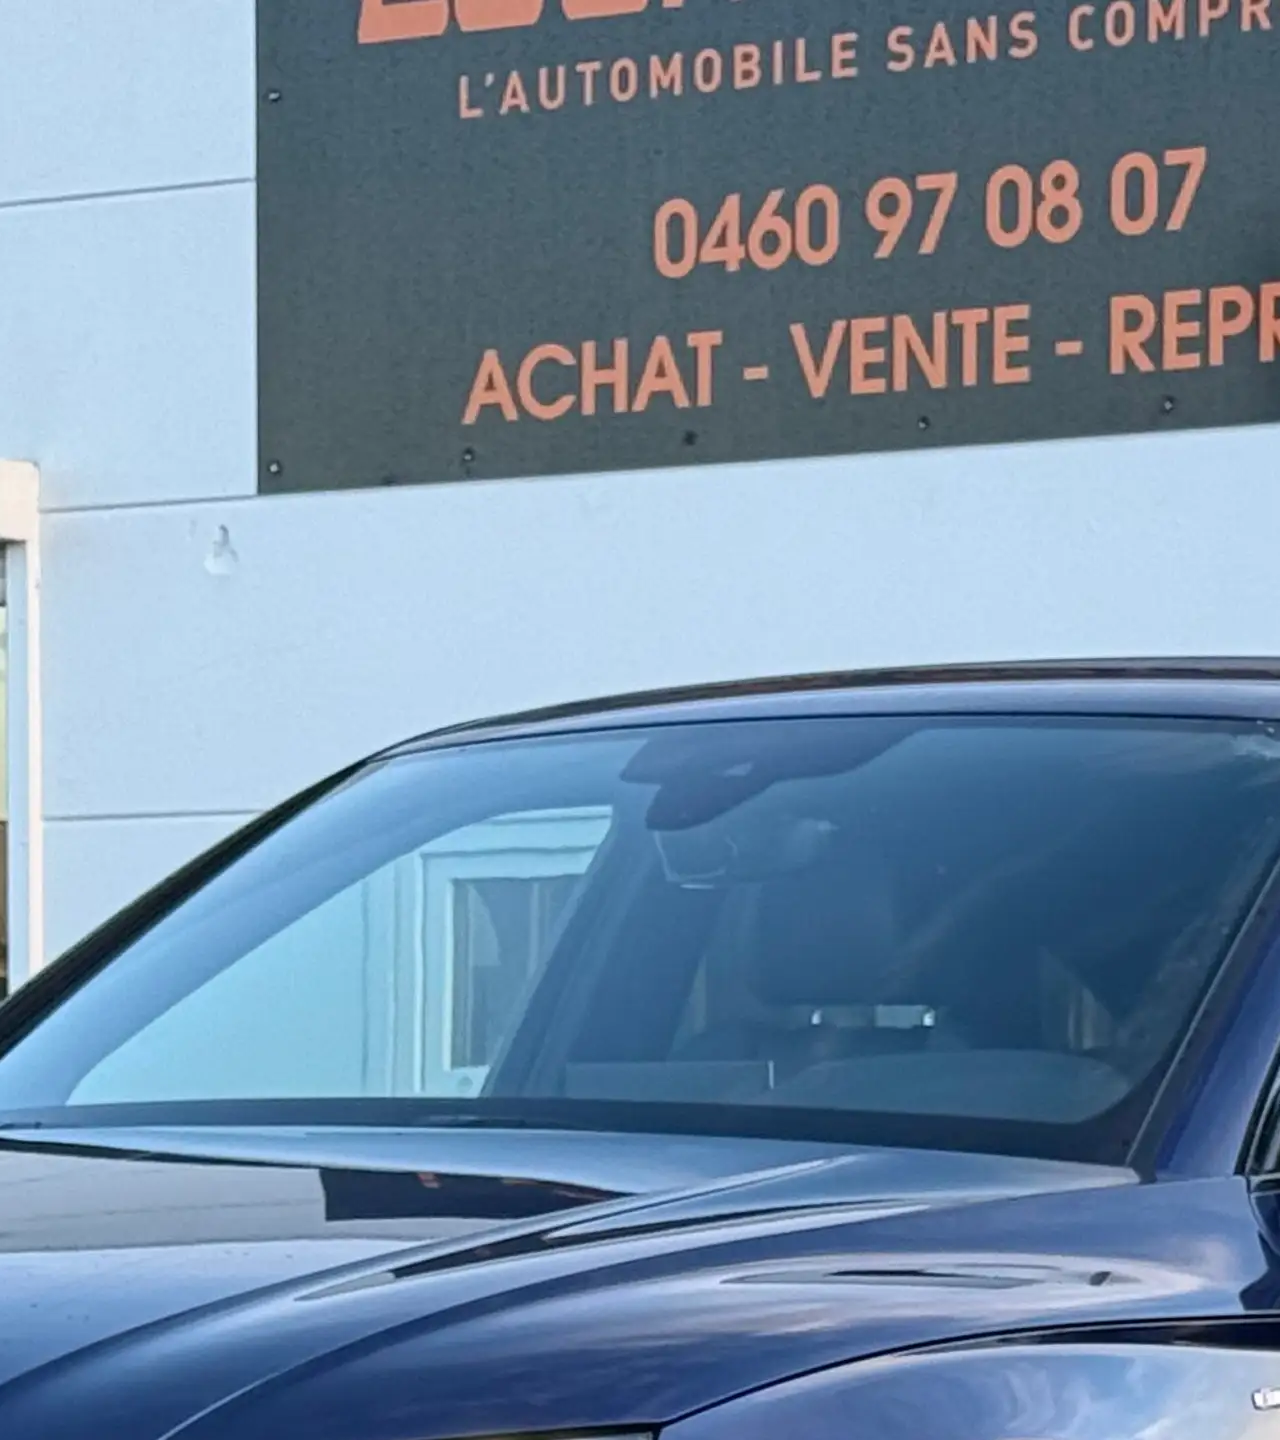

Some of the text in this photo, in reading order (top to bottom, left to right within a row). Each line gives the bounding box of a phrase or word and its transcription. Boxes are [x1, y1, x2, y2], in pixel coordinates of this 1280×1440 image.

[458, 32, 859, 119] L'AUTOMOBILE
[887, 12, 1038, 71] SANS
[653, 147, 1208, 278] 0460 97 08 07
[461, 330, 723, 424] ACHAT
[790, 303, 1031, 399] VENTE
